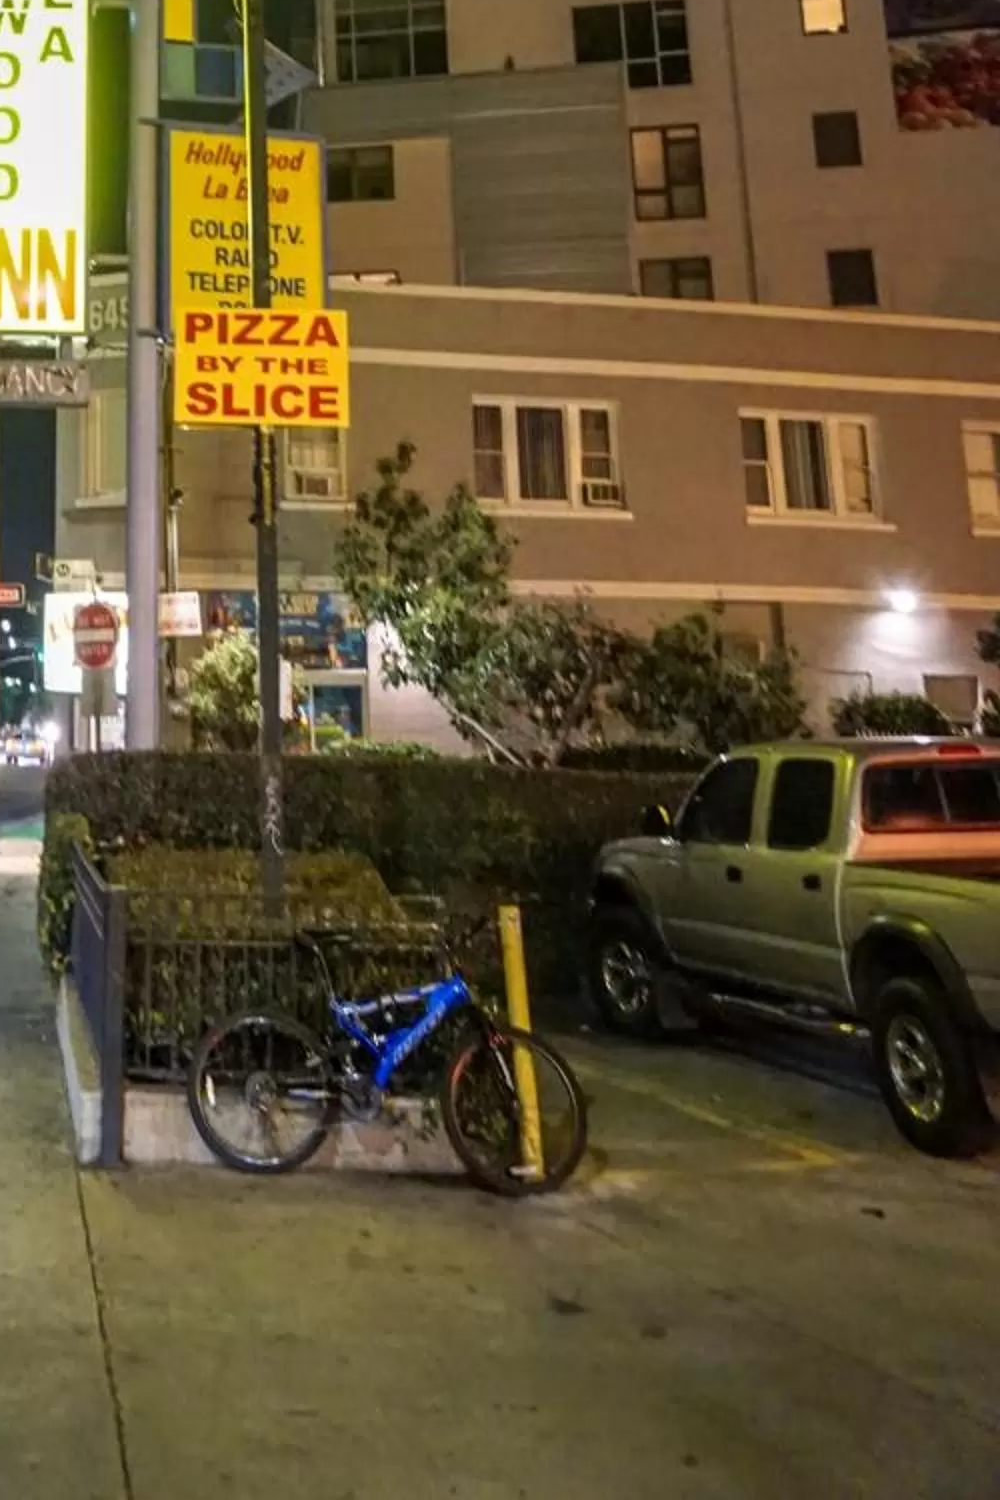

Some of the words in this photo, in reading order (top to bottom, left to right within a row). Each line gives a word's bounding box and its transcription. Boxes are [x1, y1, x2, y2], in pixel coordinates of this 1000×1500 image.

[185, 140, 305, 176] Hollyood
[203, 174, 229, 200] La
[190, 218, 250, 241] COLO
[187, 270, 306, 298] TELEPONE
[185, 312, 340, 347] PIZZA
[196, 355, 244, 373] BY
[255, 356, 329, 376] THE
[185, 382, 340, 420] SLICE
